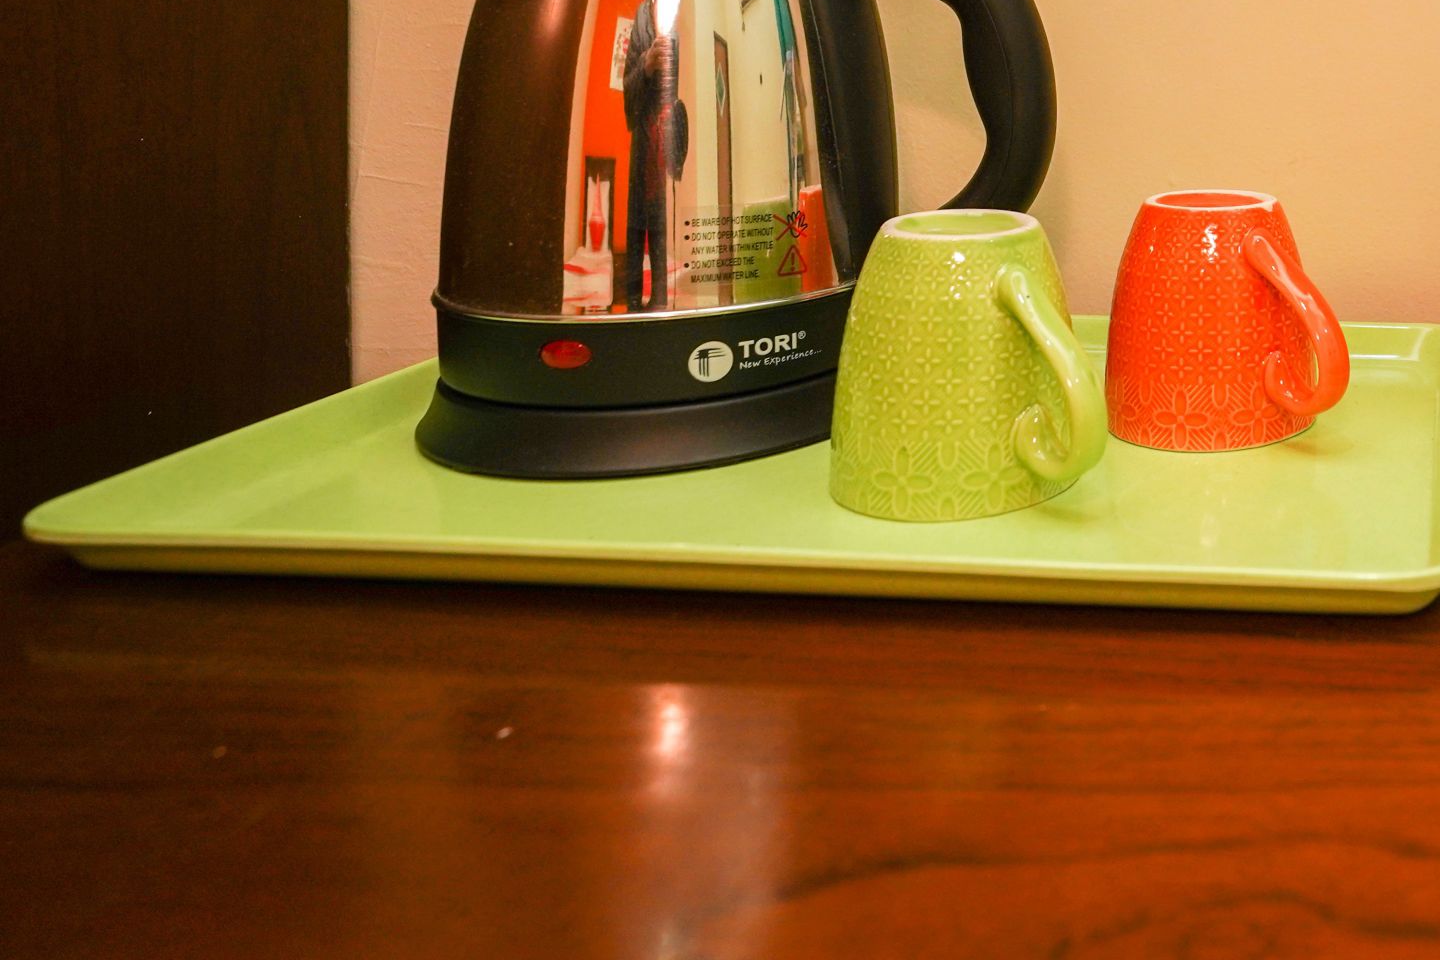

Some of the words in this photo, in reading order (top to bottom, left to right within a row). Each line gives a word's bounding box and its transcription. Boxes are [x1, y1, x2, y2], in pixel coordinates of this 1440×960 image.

[691, 218, 700, 227] BE
[702, 216, 720, 227] WARE
[745, 214, 772, 224] SURFACE
[691, 232, 701, 241] DO
[703, 231, 716, 241] NOT
[717, 229, 746, 240] OPERATE
[747, 227, 774, 237] WITHOUT
[691, 246, 705, 255] ANY
[706, 244, 728, 255] WATER
[752, 240, 773, 251] KETTLE
[691, 260, 700, 269] DO
[702, 259, 716, 268] NOT
[716, 257, 742, 267] EXCEED
[743, 256, 755, 265] THE
[691, 273, 720, 283] MAXIMUM
[721, 270, 744, 281] WATER
[745, 269, 759, 279] LINE
[739, 359, 760, 370] New
